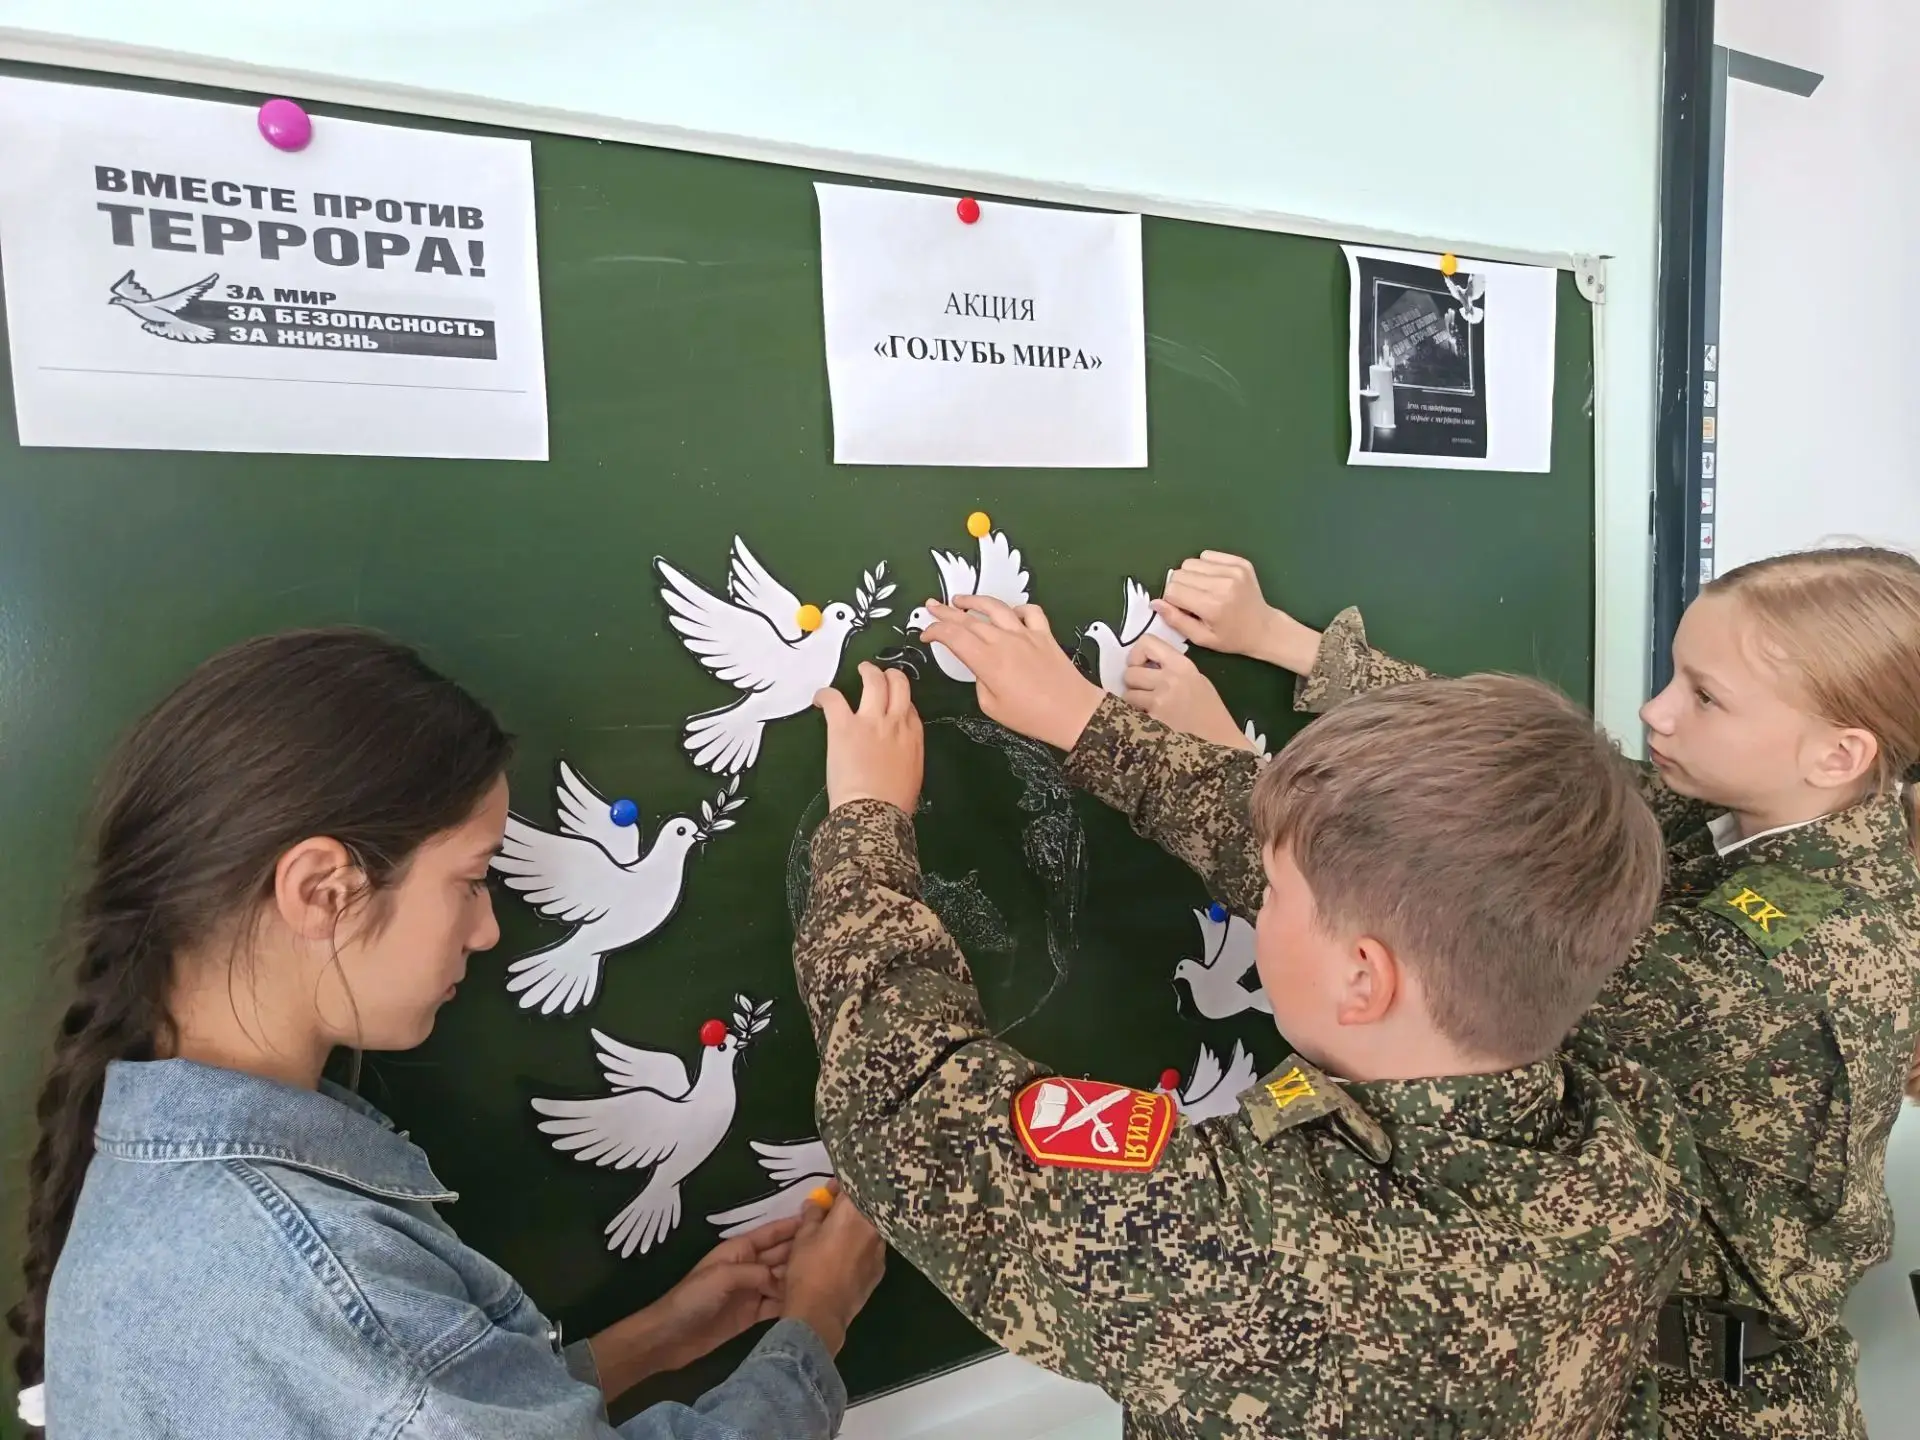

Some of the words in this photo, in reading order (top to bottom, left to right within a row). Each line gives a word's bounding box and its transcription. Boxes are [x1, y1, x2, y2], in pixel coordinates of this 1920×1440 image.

[95, 165, 296, 213] ВМЕСТЕ
[314, 193, 484, 230] ПРОТИВ
[97, 203, 486, 277] ТЕРРОРА!
[226, 285, 265, 301] ЗА
[274, 288, 337, 306] МИР
[944, 292, 1035, 323] АКЦИЯ
[228, 306, 266, 323] ЗА
[276, 309, 485, 337] БЕЗОПАСНОСТЬ
[229, 327, 268, 343] ЗА
[277, 329, 379, 350] ЖИЗНЬ
[874, 335, 1006, 365] «ГОЛУБЬ
[1013, 343, 1103, 371] МИРА»
[1727, 888, 1787, 933] КК
